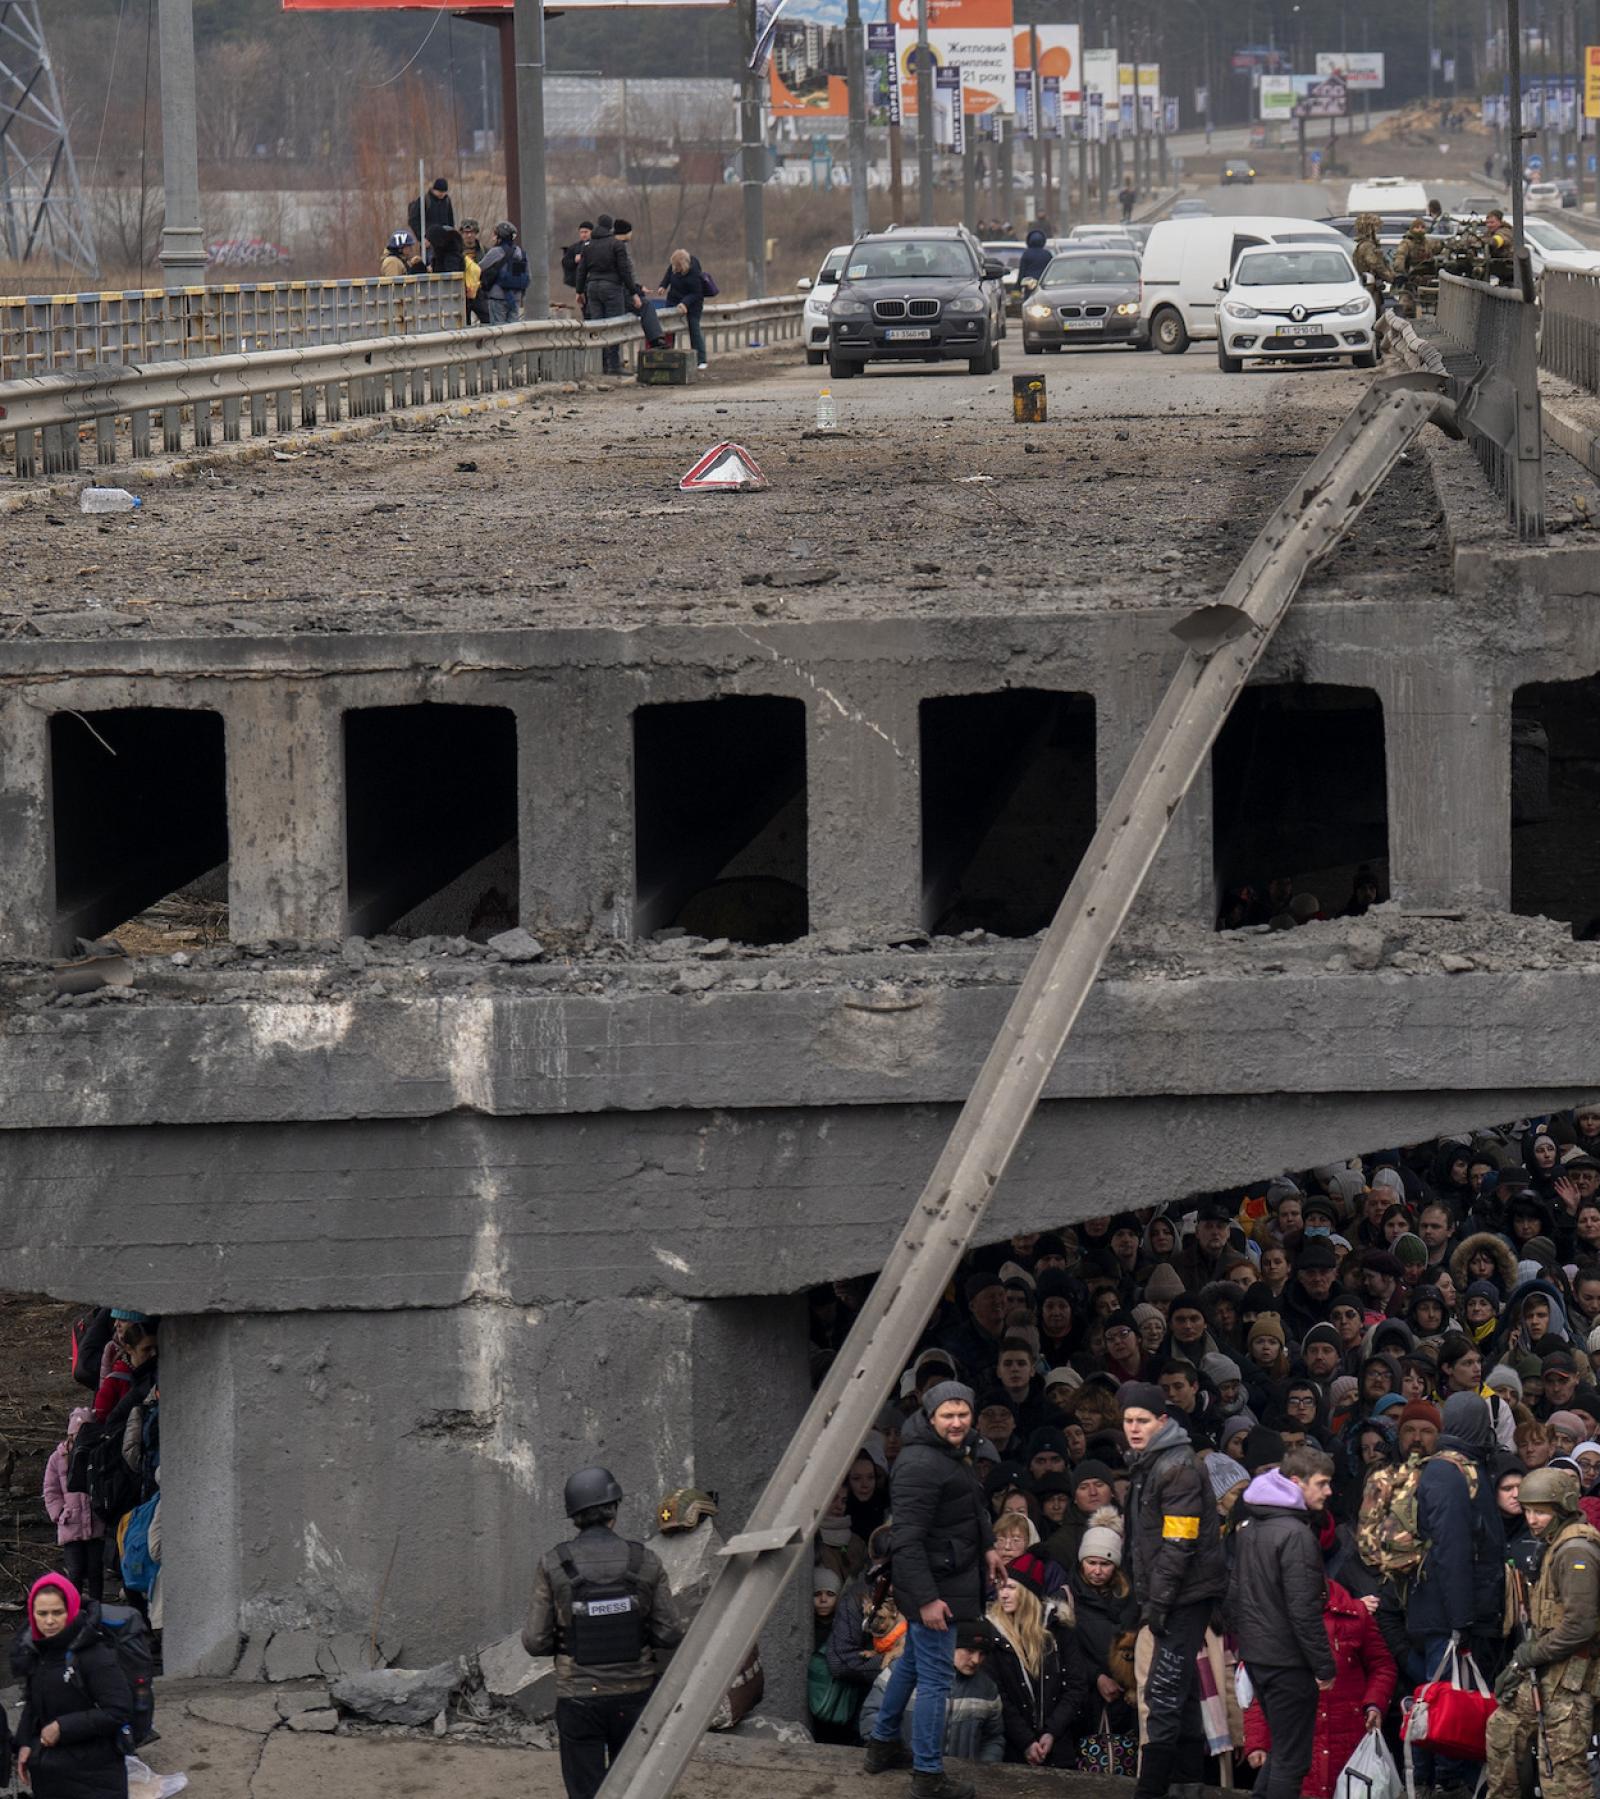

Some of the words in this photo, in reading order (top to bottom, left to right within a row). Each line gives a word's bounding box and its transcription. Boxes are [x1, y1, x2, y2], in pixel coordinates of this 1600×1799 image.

[948, 42, 1007, 54] Житловий
[948, 58, 1003, 68] комплекс
[962, 71, 978, 82] 21
[979, 73, 1007, 84] року
[393, 233, 408, 246] TV
[590, 1602, 628, 1614] PRESS
